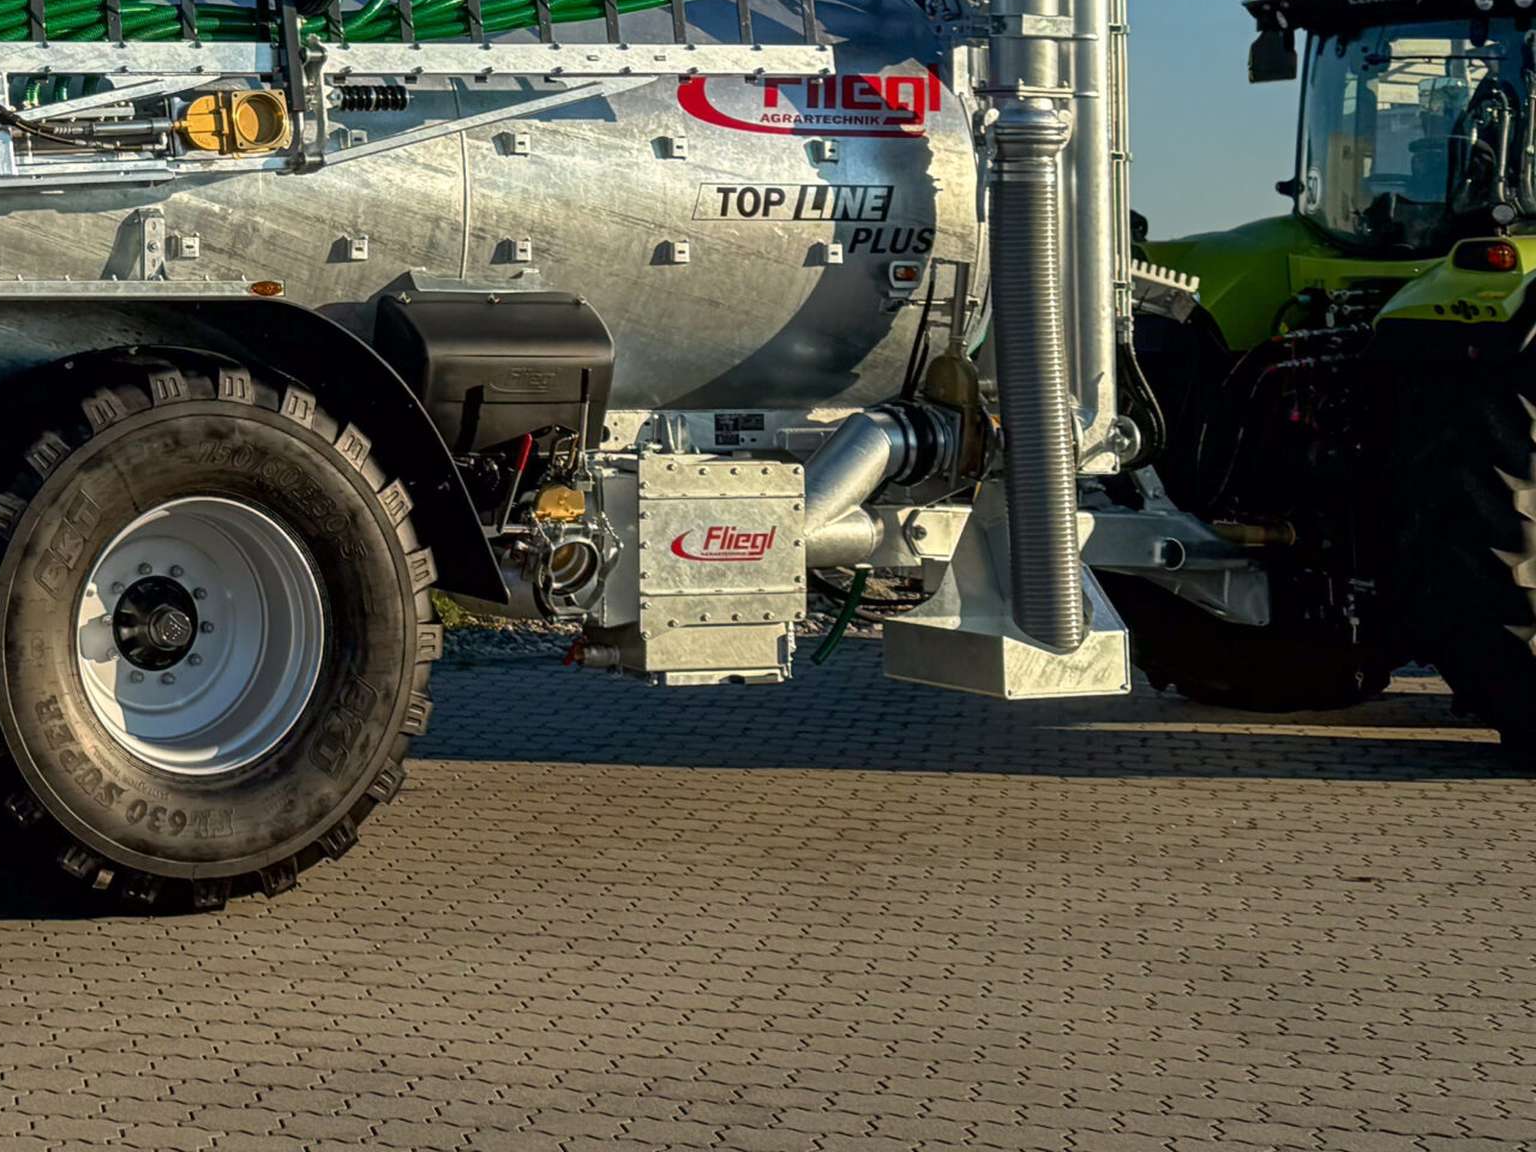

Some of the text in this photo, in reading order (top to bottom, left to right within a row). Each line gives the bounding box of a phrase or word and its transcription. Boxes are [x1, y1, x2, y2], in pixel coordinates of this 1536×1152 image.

[759, 113, 881, 126] AGRARTECHNIK
[716, 184, 890, 221] TOP LINE
[847, 227, 935, 254] PLUS
[702, 524, 777, 556] Fliegl
[34, 695, 129, 808] SUPER
